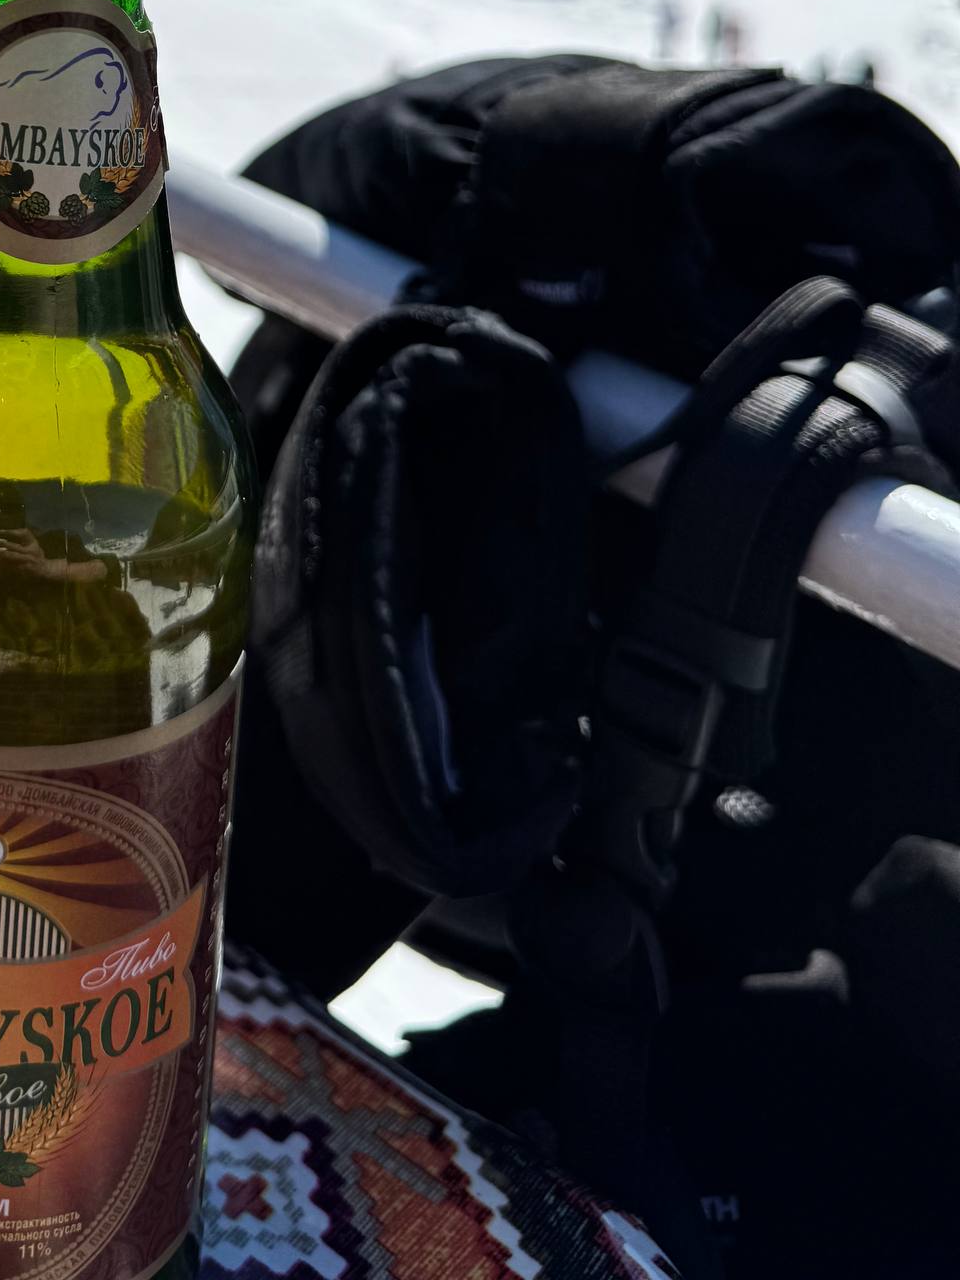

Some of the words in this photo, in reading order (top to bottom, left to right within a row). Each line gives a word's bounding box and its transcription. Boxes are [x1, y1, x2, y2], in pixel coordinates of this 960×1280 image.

[80, 930, 176, 991] Пиво
[53, 1222, 83, 1239] сусла
[19, 1241, 52, 1259] 11%
